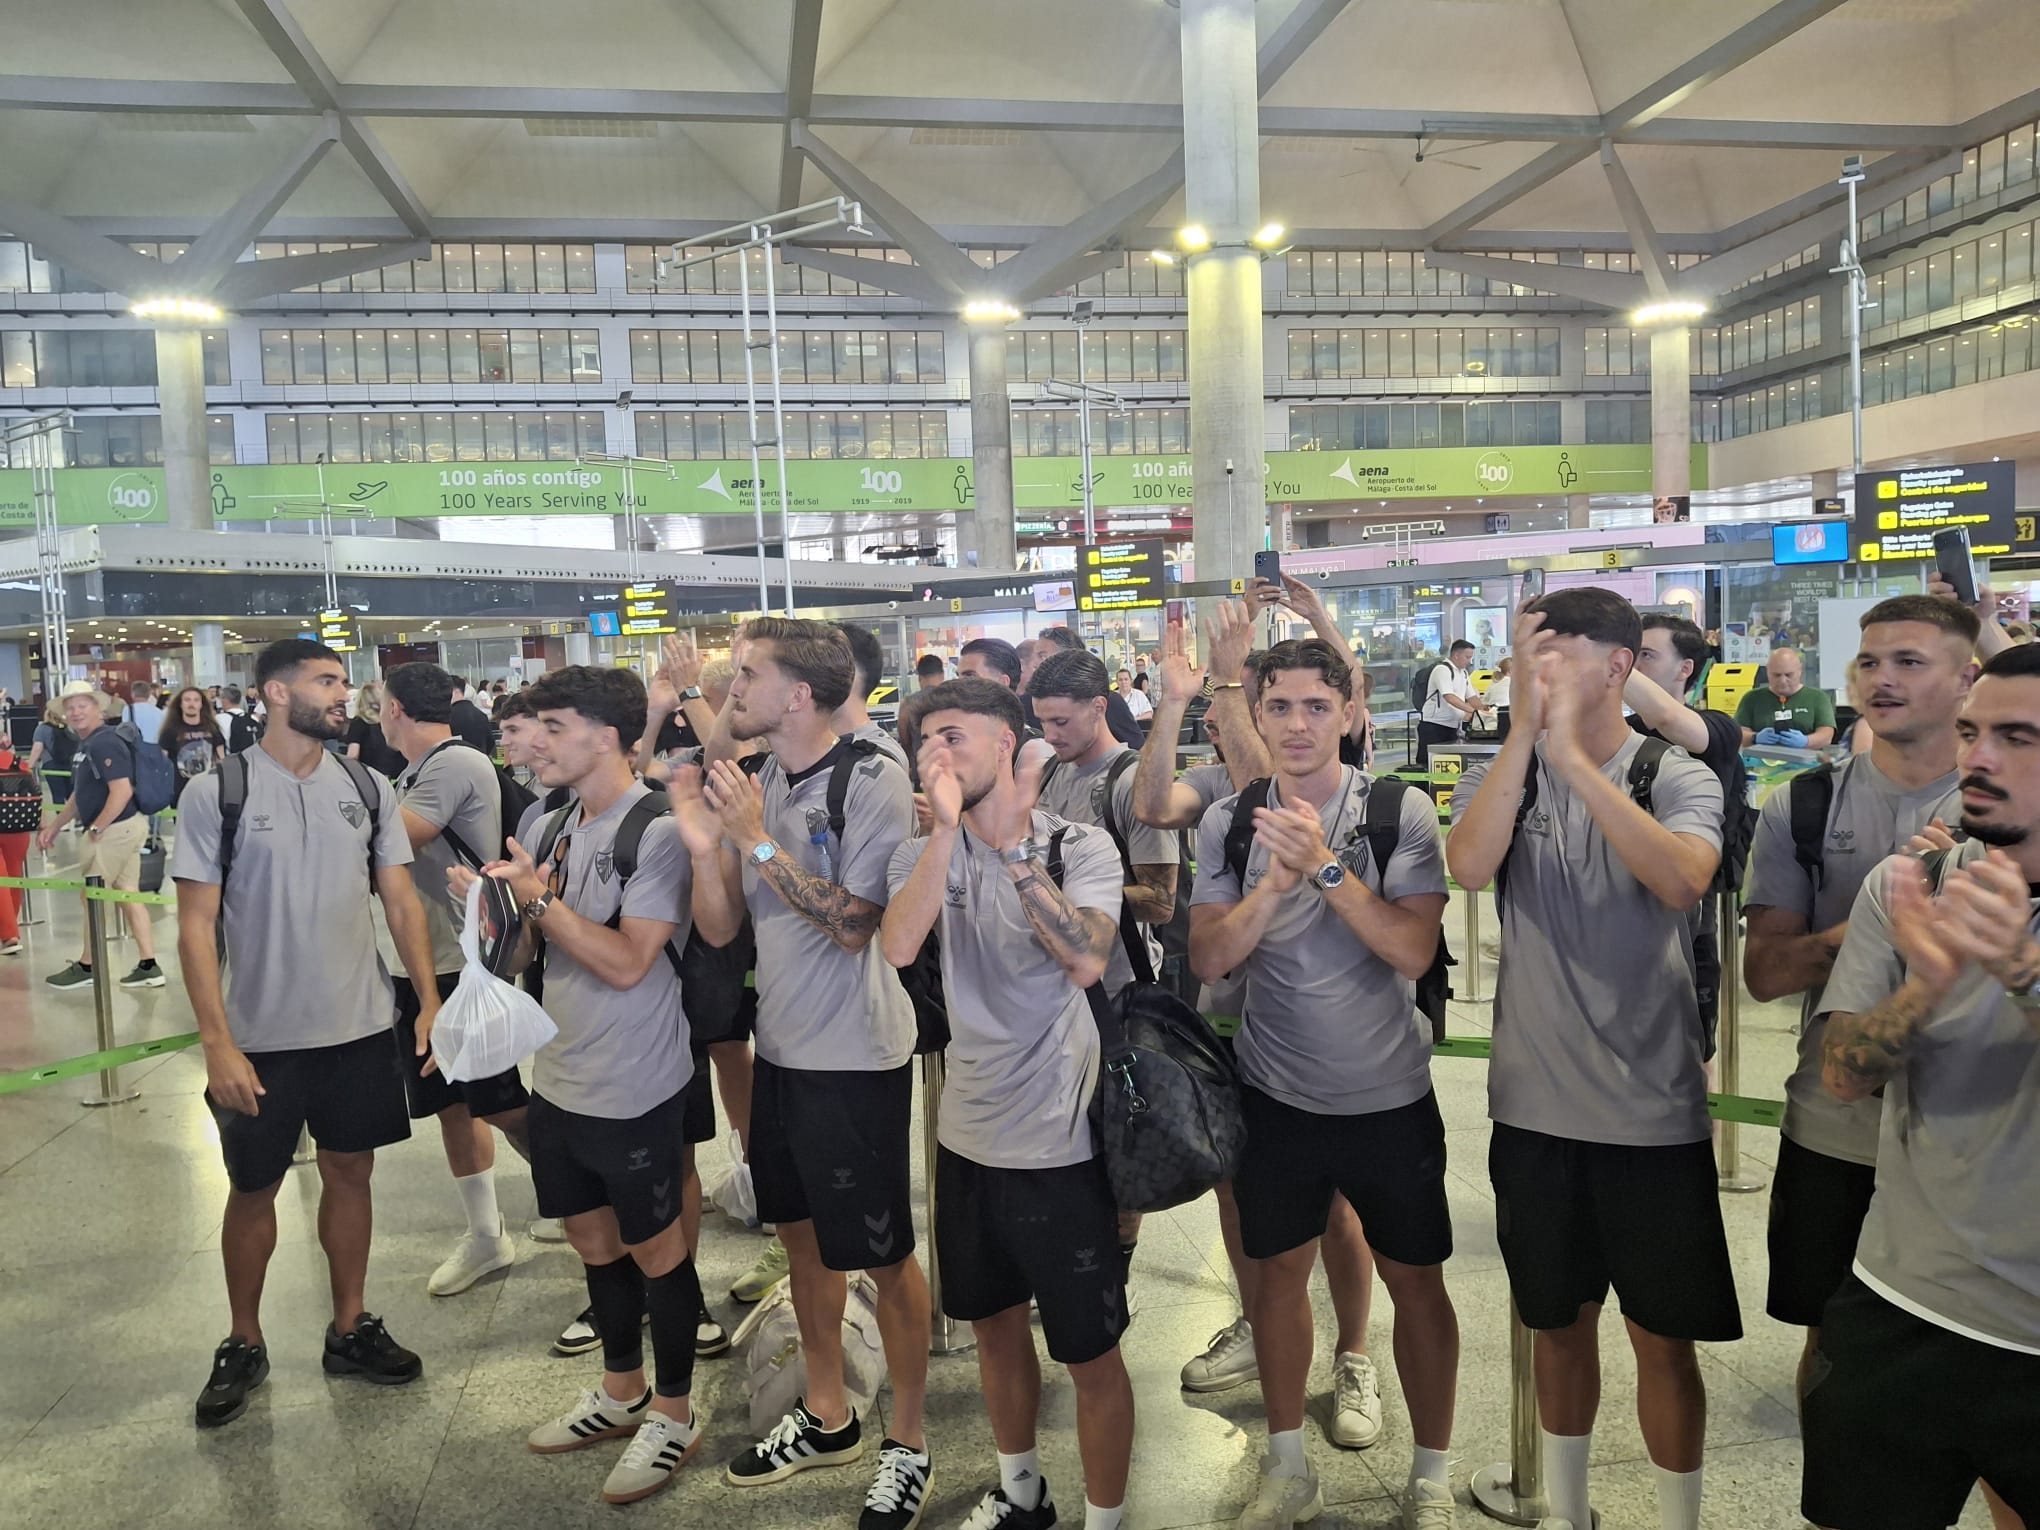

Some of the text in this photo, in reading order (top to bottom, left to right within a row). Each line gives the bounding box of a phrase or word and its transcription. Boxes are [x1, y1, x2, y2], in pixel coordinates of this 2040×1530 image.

[1132, 461, 1192, 478] 100 añ
[1359, 466, 1389, 476] aena
[1479, 463, 1508, 481] 100
[439, 469, 602, 488] 100 años contigo
[860, 467, 902, 493] 100
[1132, 483, 1192, 498] 100 Yea
[1273, 481, 1301, 495] You
[113, 486, 150, 507] 100
[440, 493, 475, 509] 100
[484, 493, 532, 508] Years
[541, 492, 607, 510] Serving
[894, 497, 912, 505] 2019
[1607, 553, 1616, 564] 3
[1234, 581, 1241, 590] 4
[953, 602, 959, 610] 5
